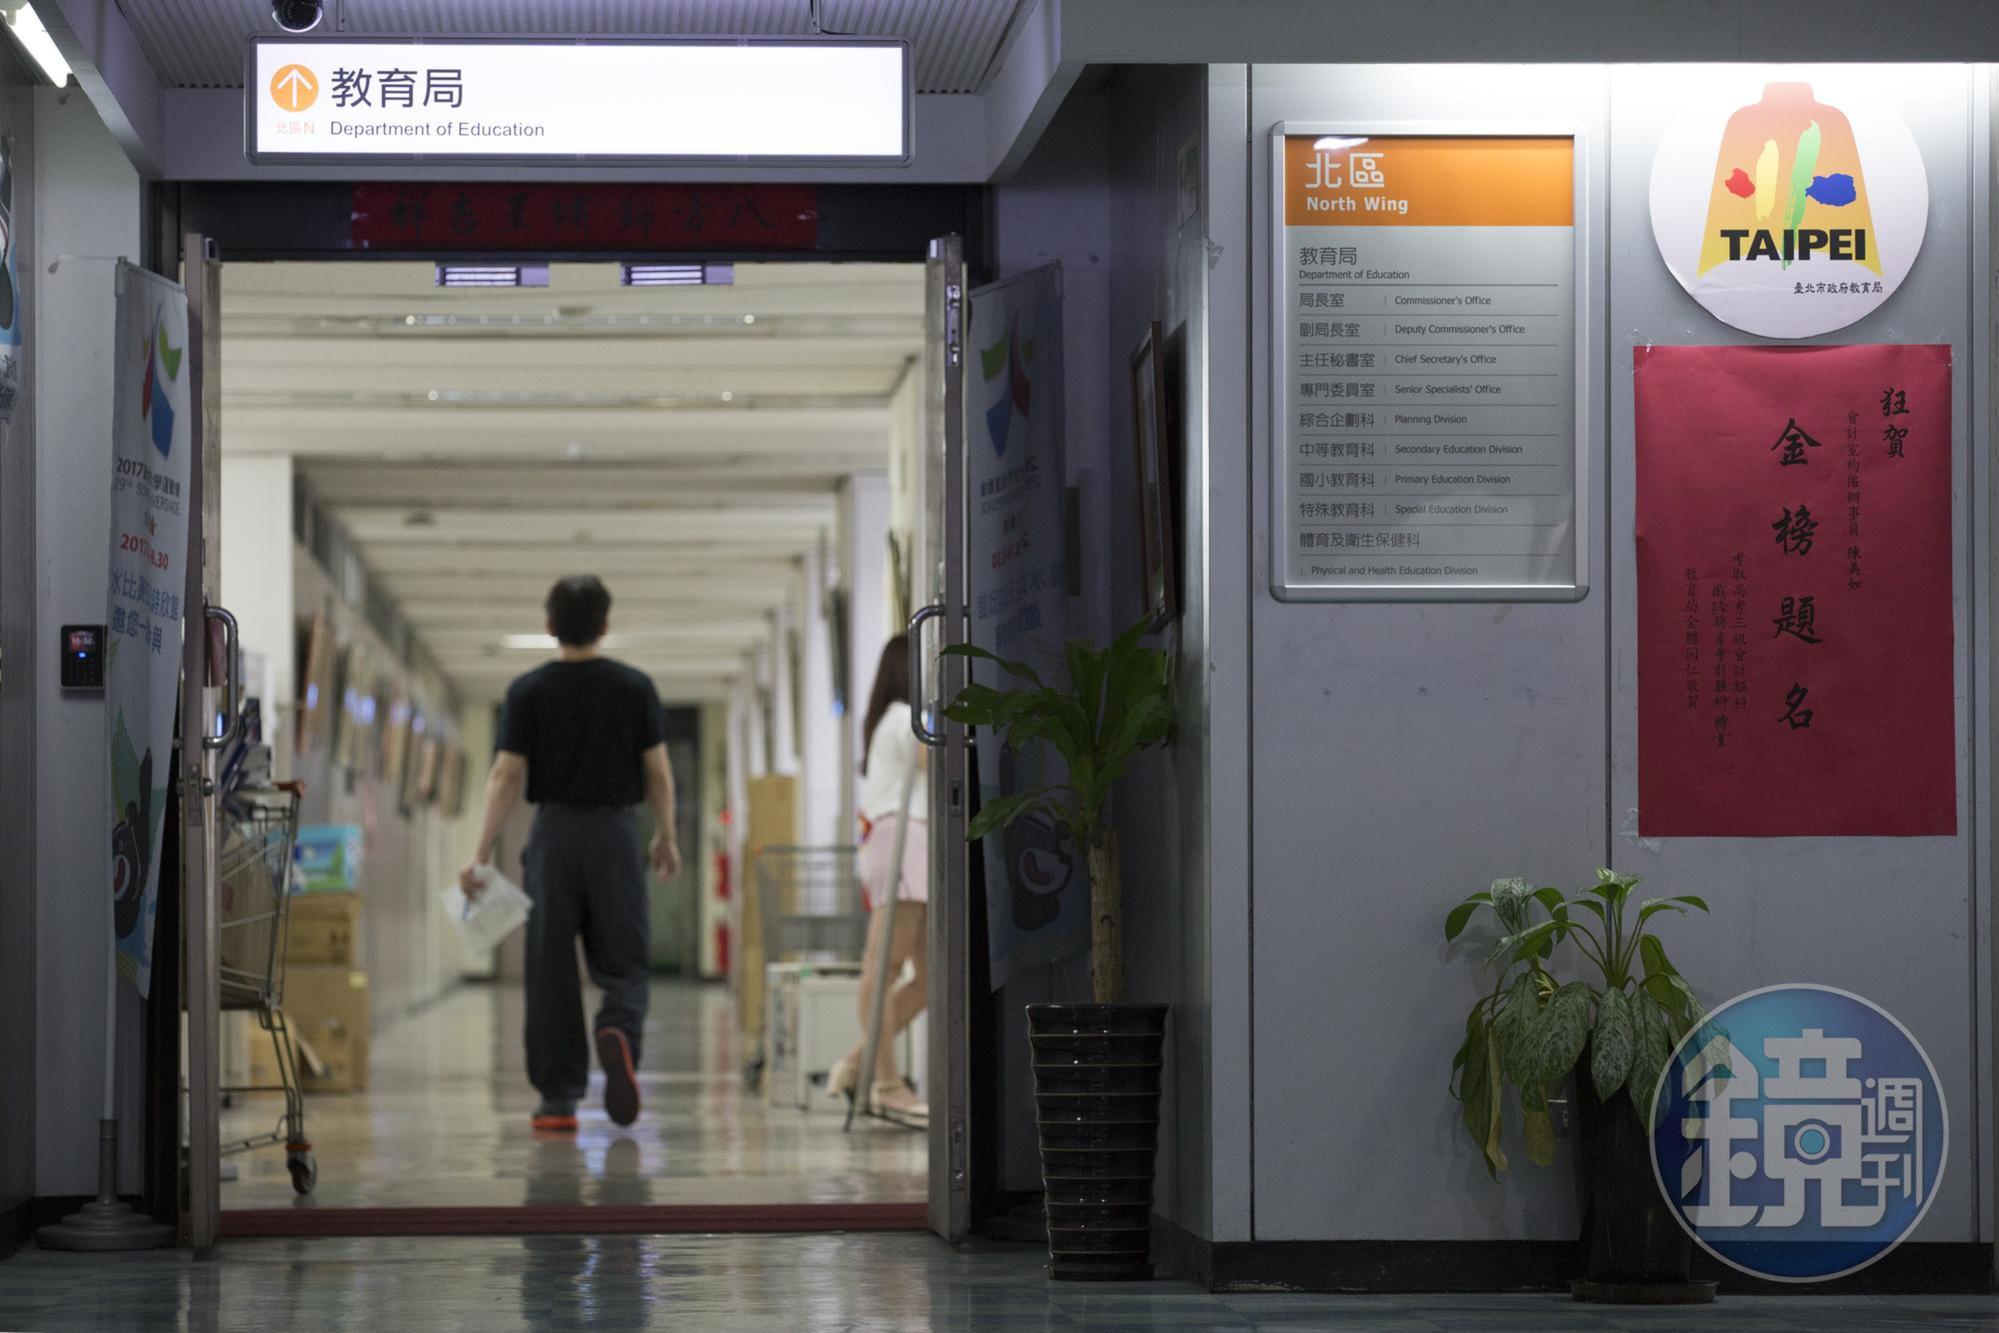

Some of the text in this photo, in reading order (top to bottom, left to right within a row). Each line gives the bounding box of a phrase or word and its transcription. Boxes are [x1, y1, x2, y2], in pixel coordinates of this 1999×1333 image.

[332, 68, 462, 108] 教育局
[303, 121, 314, 134] N
[331, 121, 544, 138] Department of Education
[1305, 152, 1384, 189] 北區
[1307, 197, 1408, 214] North Wing
[1720, 229, 1865, 261] TAIPEI
[1300, 247, 1357, 265] 教育局
[1299, 270, 1409, 280] Department of Education
[1793, 282, 1883, 294] 臺北市政府教育局
[1300, 293, 1344, 307] 局長室
[1395, 296, 1491, 305] Commissioner's Office
[1300, 323, 1360, 337] 副局長室
[1395, 324, 1525, 335] Deputy Commissioner's Office
[1300, 353, 1375, 368] 主任秘書室
[1395, 354, 1496, 365] Chief Secretary's Office
[1300, 383, 1375, 397] 專門委員室
[1395, 385, 1501, 395] Senior Specialists' Office
[1300, 413, 1374, 428] 綜合企劃科
[1395, 415, 1467, 426] Planning Division
[1880, 387, 1910, 458] 狂賀
[1300, 443, 1374, 458] 中等教育科
[1395, 445, 1522, 455] Secondary Education Division
[1300, 473, 1374, 487] 國小教育科
[1396, 475, 1510, 485] Primary Education Division
[1300, 503, 1374, 518] 特殊教育科
[1396, 505, 1507, 516] Special Education Division
[1300, 533, 1420, 548] 體育及衛生保健科
[1312, 566, 1478, 577] Physical and Health Education Division
[1771, 417, 1823, 730] 金榜題名
